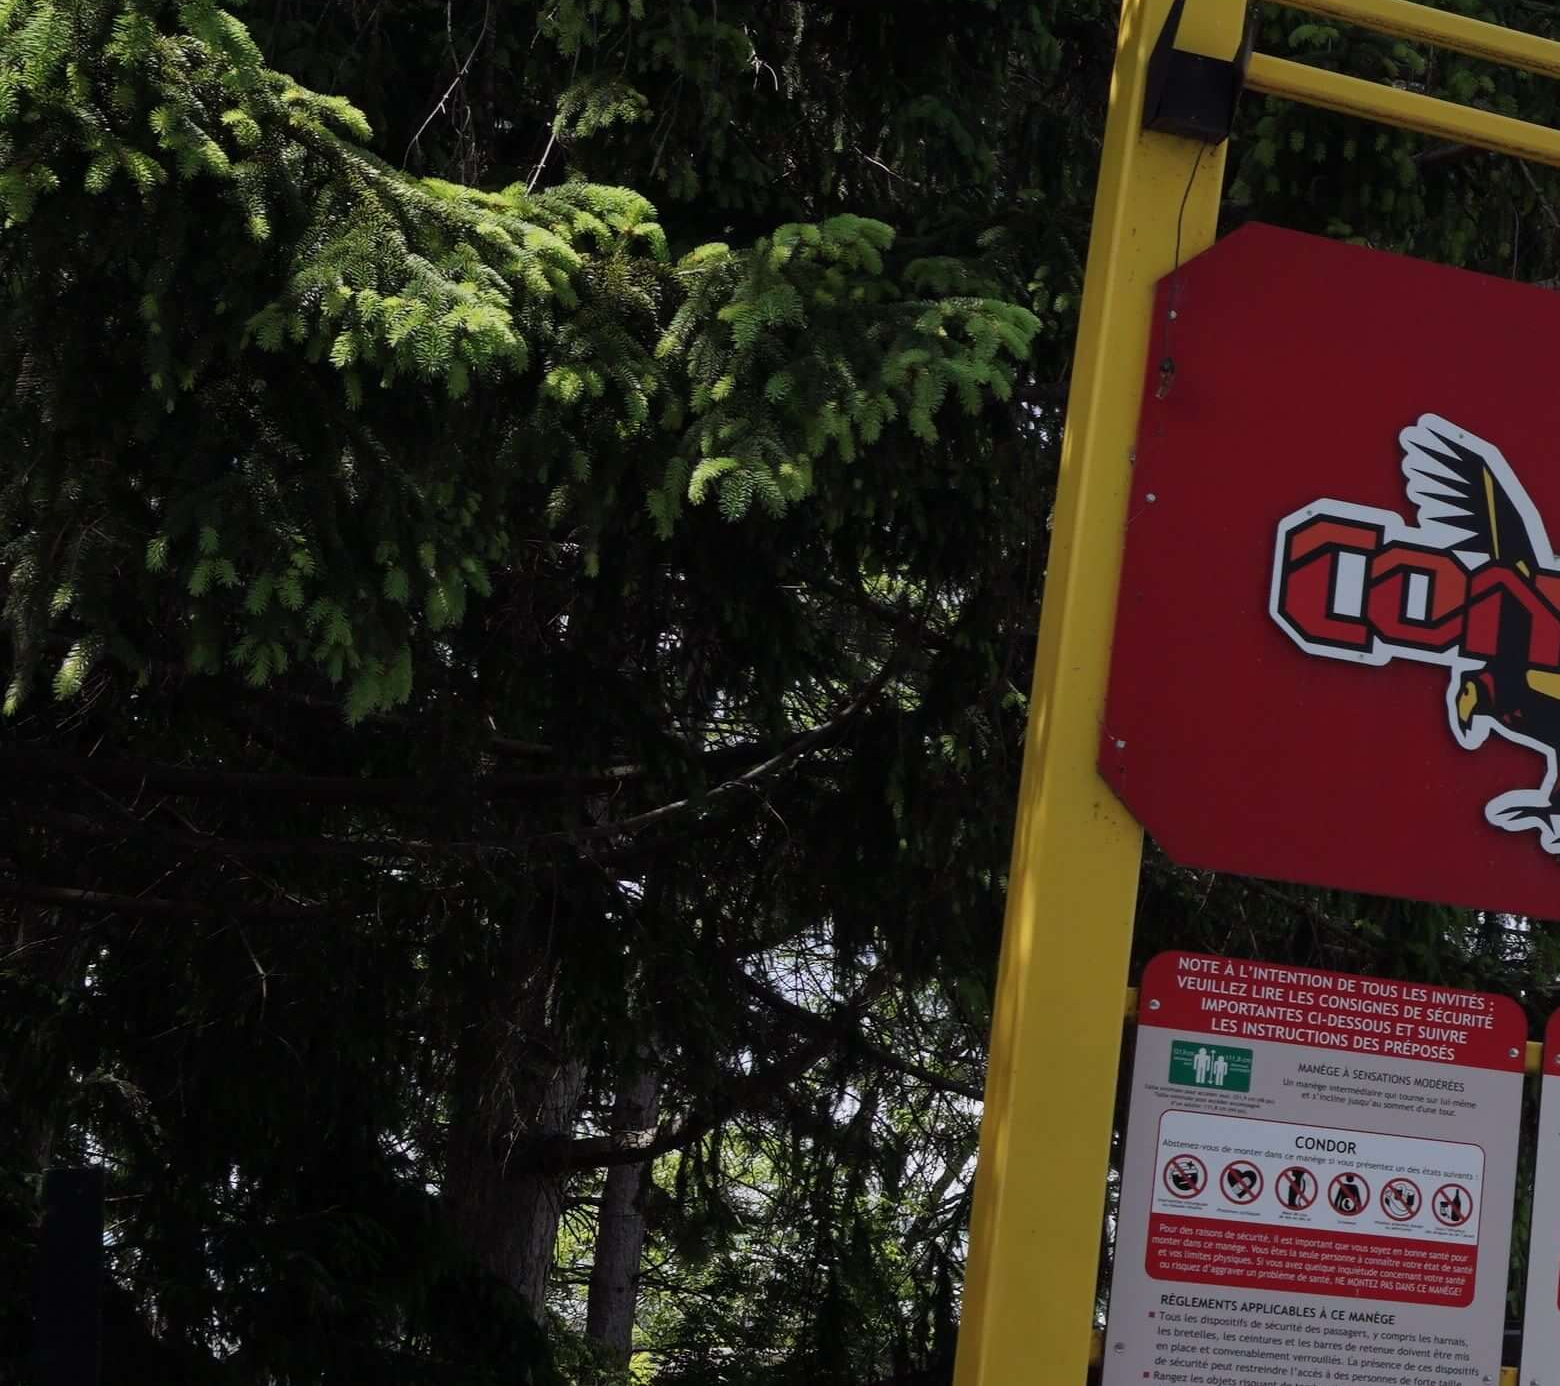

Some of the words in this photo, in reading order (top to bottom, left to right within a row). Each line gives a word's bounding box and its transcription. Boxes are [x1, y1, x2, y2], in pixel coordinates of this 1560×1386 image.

[1177, 975, 1248, 997] VEUILLEZ
[1252, 984, 1285, 1002] LIRE
[1288, 989, 1314, 1006] LES
[1318, 994, 1399, 1017] CONSIGNES
[1403, 1005, 1423, 1020] DE
[1426, 1006, 1494, 1030] SÉCURITÉ
[1178, 956, 1221, 974] NOTE
[1223, 961, 1235, 977] À
[1239, 964, 1333, 990] L'INTENTION
[1337, 977, 1357, 993] DE
[1360, 981, 1398, 998] TOUS
[1402, 986, 1428, 1002] LES
[1431, 990, 1485, 1010] INVITÉS
[1201, 996, 1303, 1023] IMPORTANTES
[1307, 1011, 1392, 1034] CI-DESSOUS
[1395, 1022, 1415, 1037] ET
[1417, 1025, 1468, 1045] SUIVRE
[1211, 1017, 1238, 1033] LES
[1242, 1021, 1349, 1048] INSTRUCTIONS
[1352, 1035, 1380, 1052] DES
[1383, 1039, 1455, 1061] PRÉPOSÉS
[1297, 1062, 1341, 1077] MANÈGE
[1341, 1068, 1350, 1078] À
[1352, 1069, 1412, 1086] SENSATIONS
[1413, 1077, 1465, 1093] MODÉRÉES
[1295, 1135, 1357, 1155] CONDOR
[1160, 1292, 1238, 1312] RÈGLEMENTS
[1239, 1302, 1316, 1318] APPLICABLES
[1319, 1309, 1328, 1319] À
[1330, 1309, 1346, 1321] CE
[1348, 1311, 1396, 1326] MANÈGE
